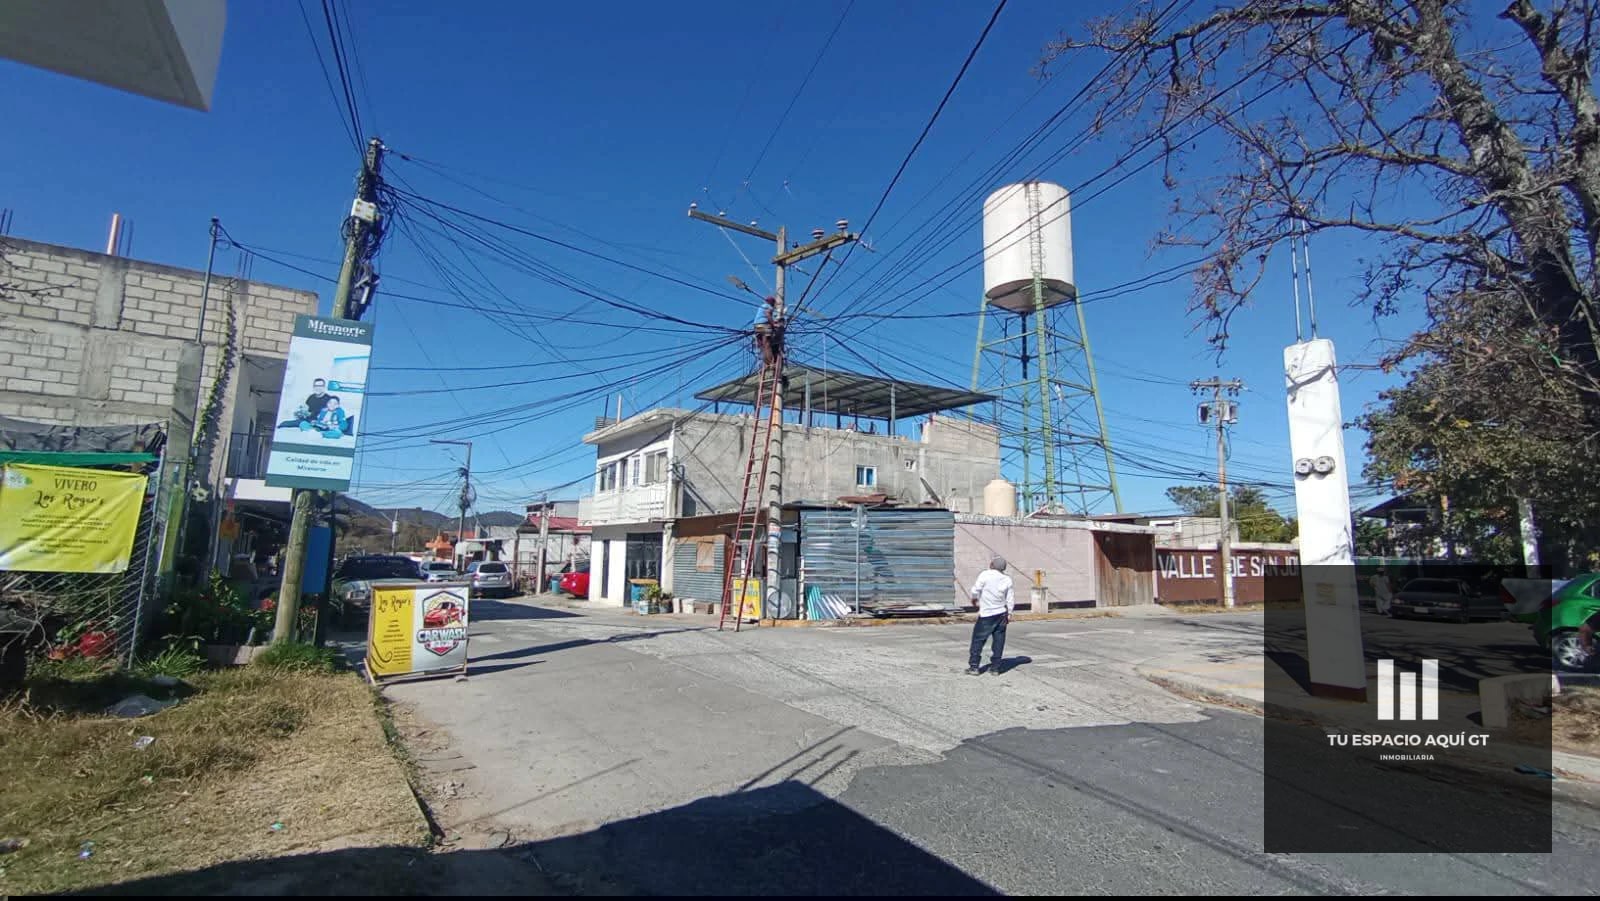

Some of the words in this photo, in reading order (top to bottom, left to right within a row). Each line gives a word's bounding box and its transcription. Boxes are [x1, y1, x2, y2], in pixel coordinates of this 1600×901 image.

[307, 319, 366, 335] Miranorte
[54, 478, 97, 491] VIVERO
[1158, 555, 1214, 579] VALLE
[1250, 556, 1278, 577] SAN
